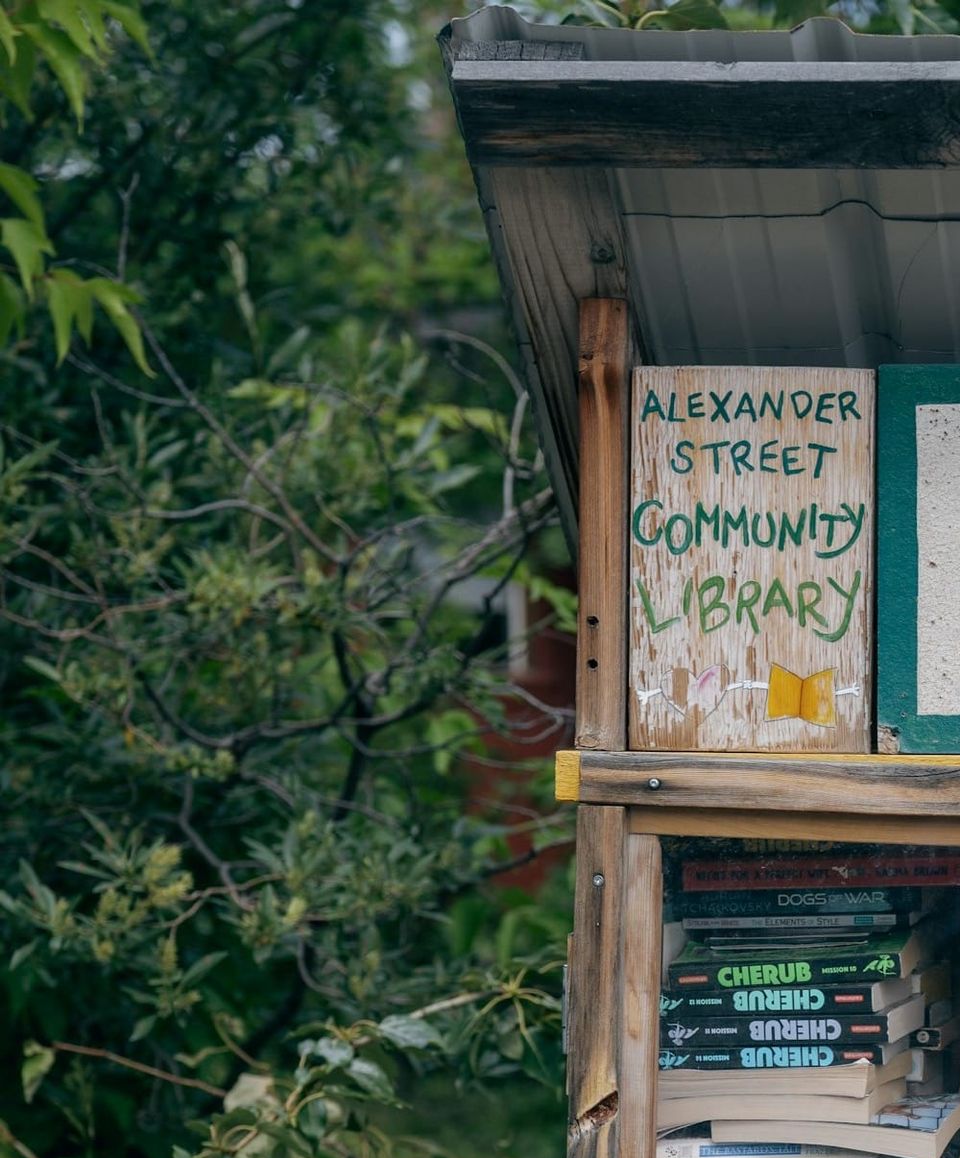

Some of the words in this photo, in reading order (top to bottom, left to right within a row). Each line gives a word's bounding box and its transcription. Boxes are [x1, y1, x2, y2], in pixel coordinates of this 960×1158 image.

[642, 390, 861, 423] ALEXANDER
[671, 440, 836, 478] STREET
[633, 500, 864, 558] COMMUNITY
[636, 571, 861, 642] LIBRARY
[778, 892, 827, 906] DOGS
[845, 891, 885, 904] WAR
[764, 916, 807, 926] ELEMENTS
[816, 915, 840, 926] STYLE
[717, 962, 812, 988] CHERUB
[732, 989, 825, 1011] CHERUB
[749, 1019, 842, 1041] CHERUB
[740, 1046, 835, 1067] CHERUB
